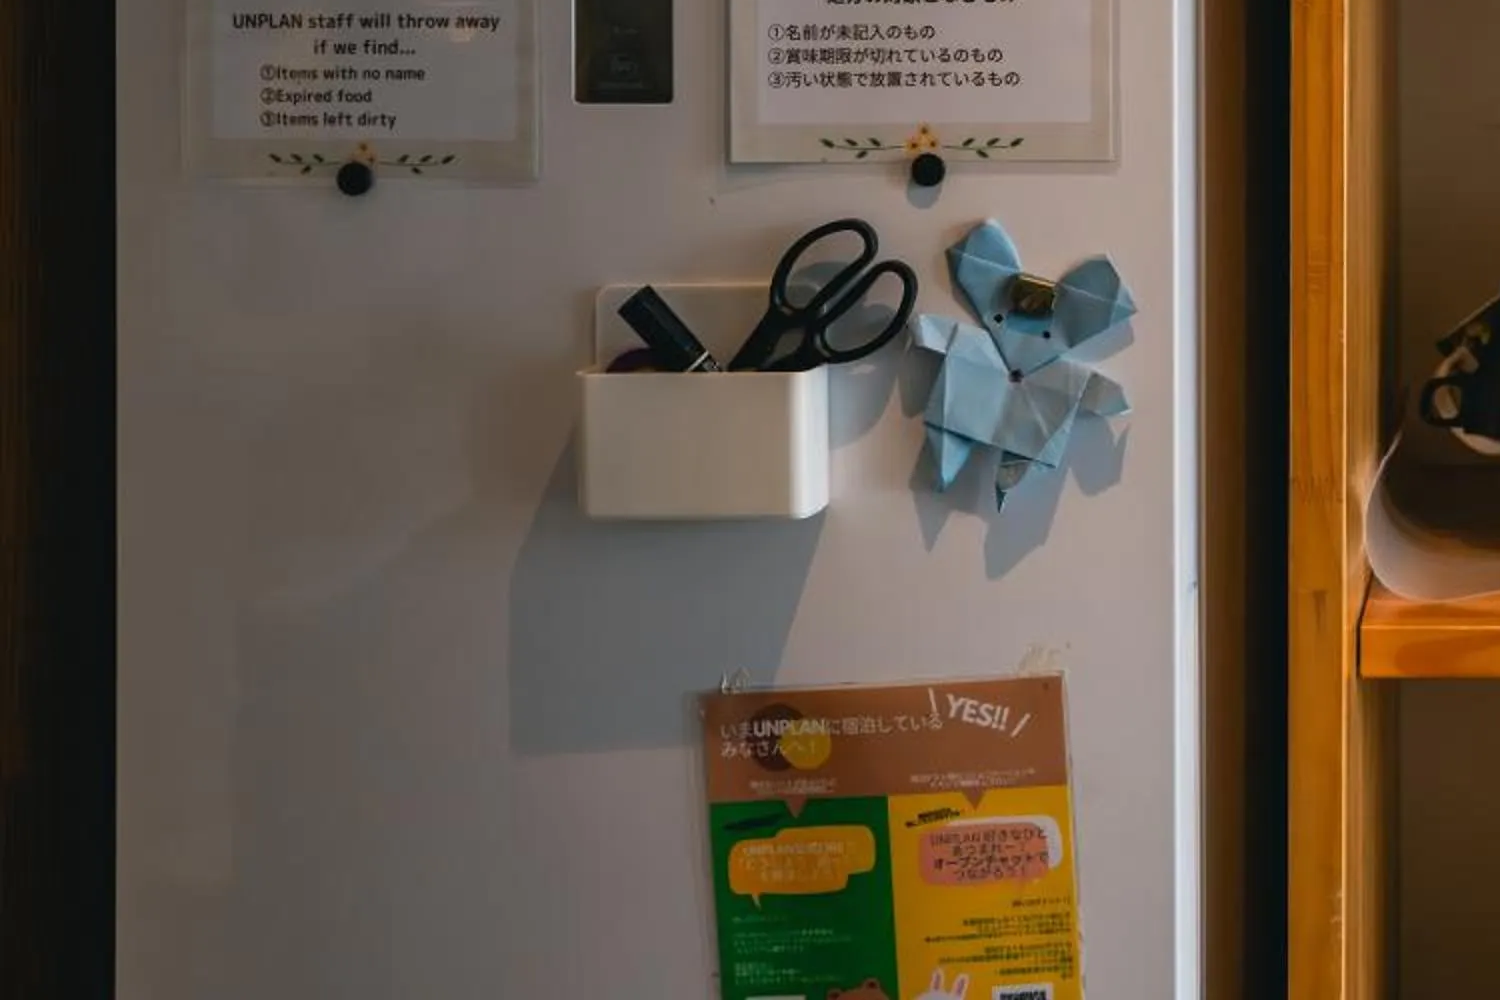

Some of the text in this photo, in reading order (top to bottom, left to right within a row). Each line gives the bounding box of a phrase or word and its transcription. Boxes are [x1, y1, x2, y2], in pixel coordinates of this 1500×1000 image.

[233, 13, 500, 32] UNPLAN staff will throw away
[768, 24, 936, 41] ①名前が未記入のもの
[313, 39, 416, 56] if we find...
[323, 66, 357, 80] with
[363, 69, 381, 80] no
[385, 68, 425, 80] name
[337, 89, 372, 103] food
[323, 111, 353, 126] left
[357, 111, 397, 129] dirty
[946, 693, 1008, 731] YES!!
[720, 712, 944, 738] いまUNPLANに宿泊している
